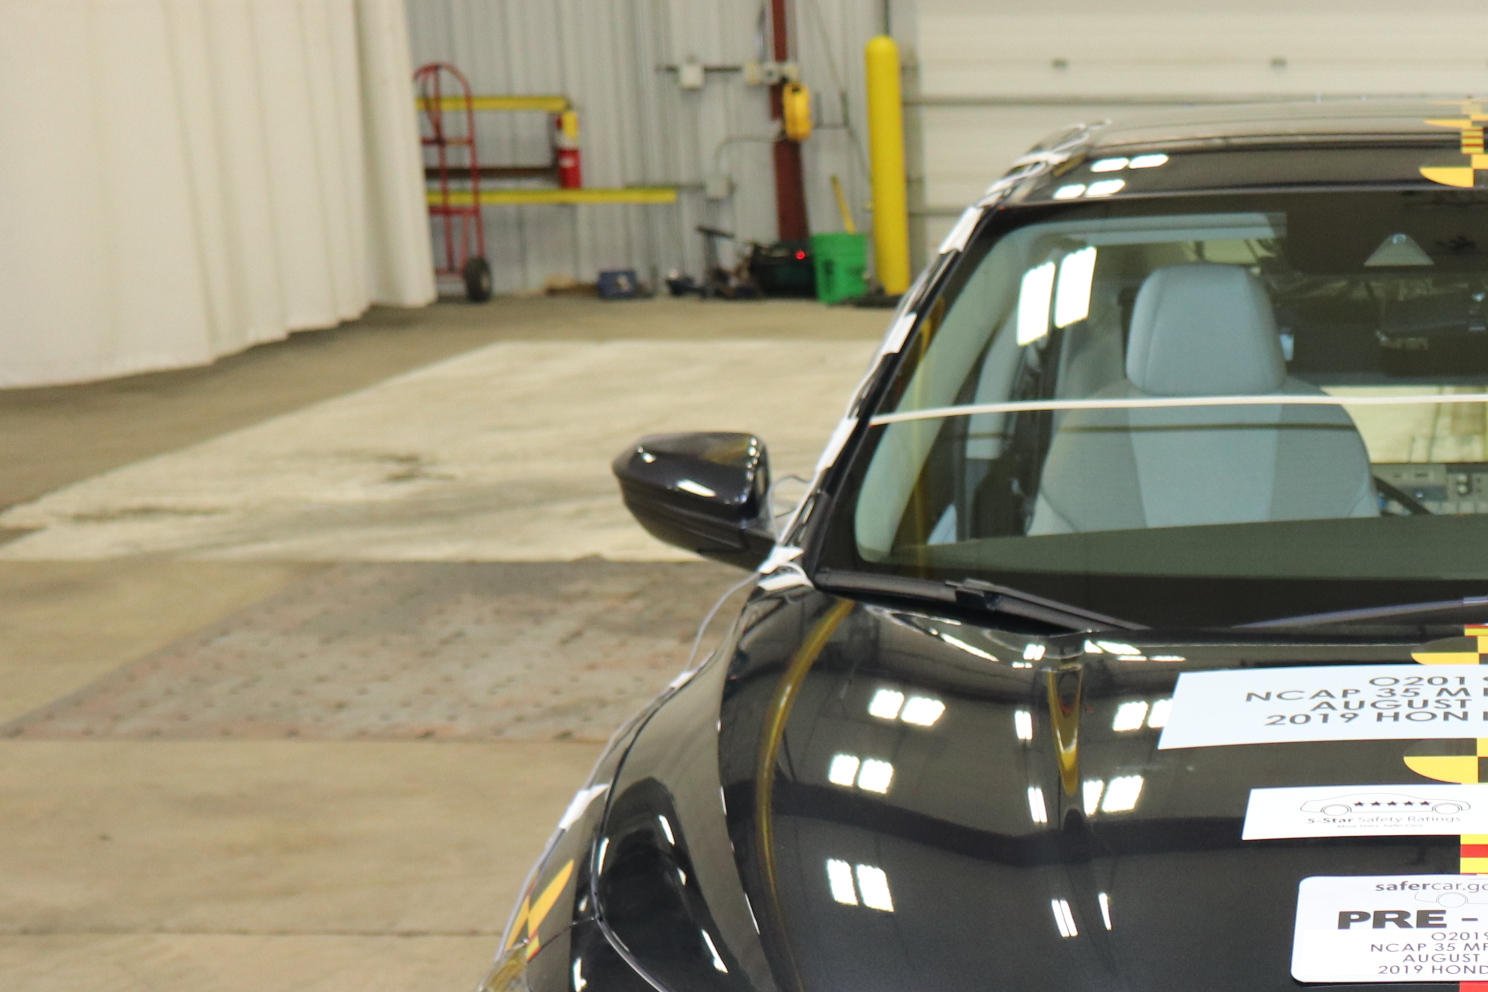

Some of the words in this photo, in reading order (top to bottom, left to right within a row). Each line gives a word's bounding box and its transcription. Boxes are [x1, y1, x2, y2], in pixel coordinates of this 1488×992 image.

[1245, 688, 1361, 702] NCAP
[1375, 687, 1421, 698] 35
[1310, 699, 1472, 712] AUGUST
[1264, 712, 1360, 726] 2019
[1358, 815, 1403, 824] Safety
[1407, 815, 1463, 824] Ratings
[1337, 909, 1447, 930] PRE
[1371, 943, 1427, 952] NCAP
[1434, 943, 1456, 952] 35
[1402, 954, 1480, 963] AUGUST
[1378, 965, 1423, 975] 2019
